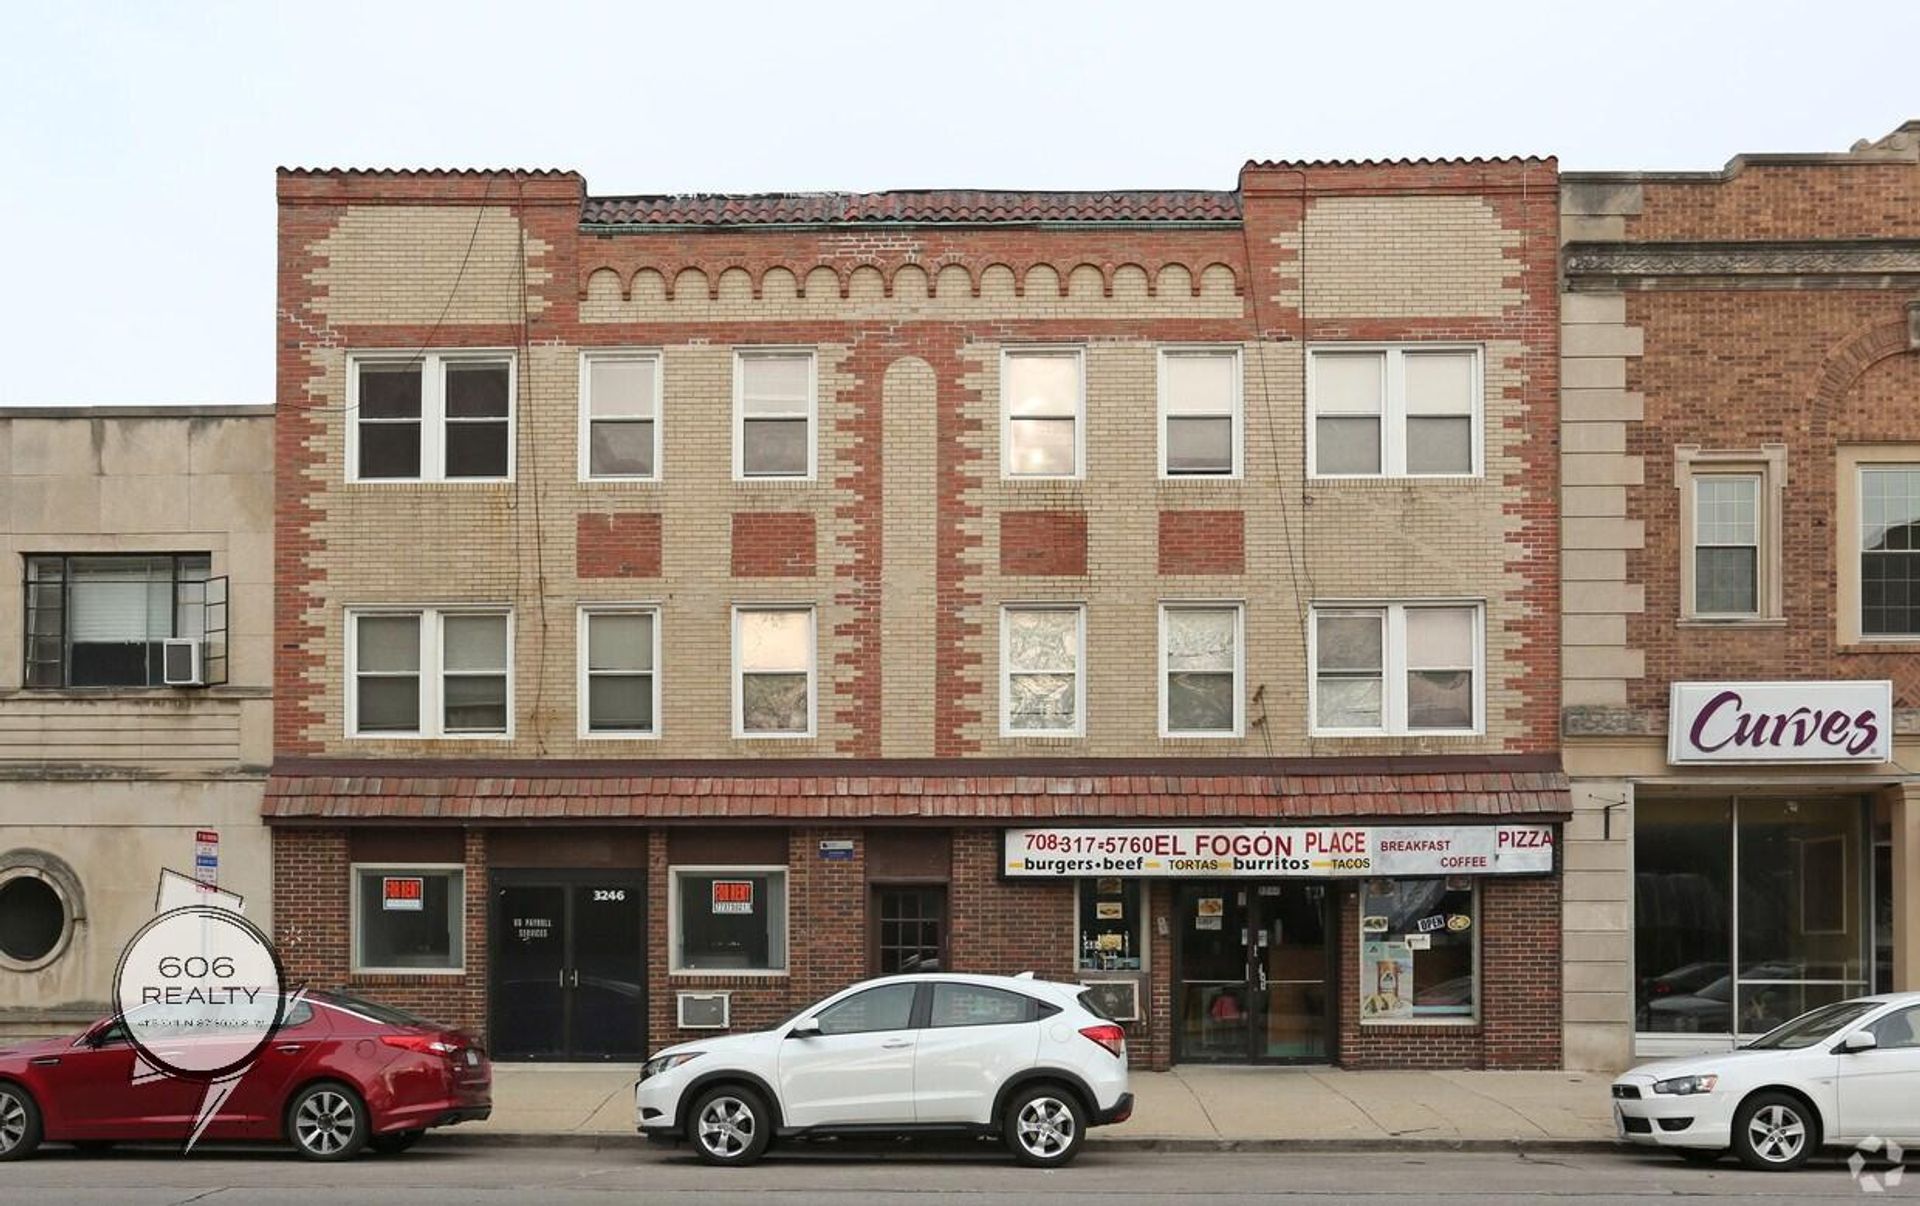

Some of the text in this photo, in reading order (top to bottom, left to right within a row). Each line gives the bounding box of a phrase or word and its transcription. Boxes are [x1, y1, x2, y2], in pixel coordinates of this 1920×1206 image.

[1689, 691, 1878, 756] Curves
[1155, 835, 1186, 855] EL
[1305, 832, 1365, 853] PLACE
[1380, 840, 1450, 852] BREAKFAST
[1498, 831, 1554, 848] PIZZA
[1168, 859, 1218, 870] TORTAS
[1233, 857, 1310, 870] burritos
[1331, 858, 1371, 869] TACOS
[1440, 856, 1487, 868] COFFEE
[593, 890, 626, 901] 3246
[1420, 914, 1444, 930] OPEN
[518, 929, 548, 938] SERVICES
